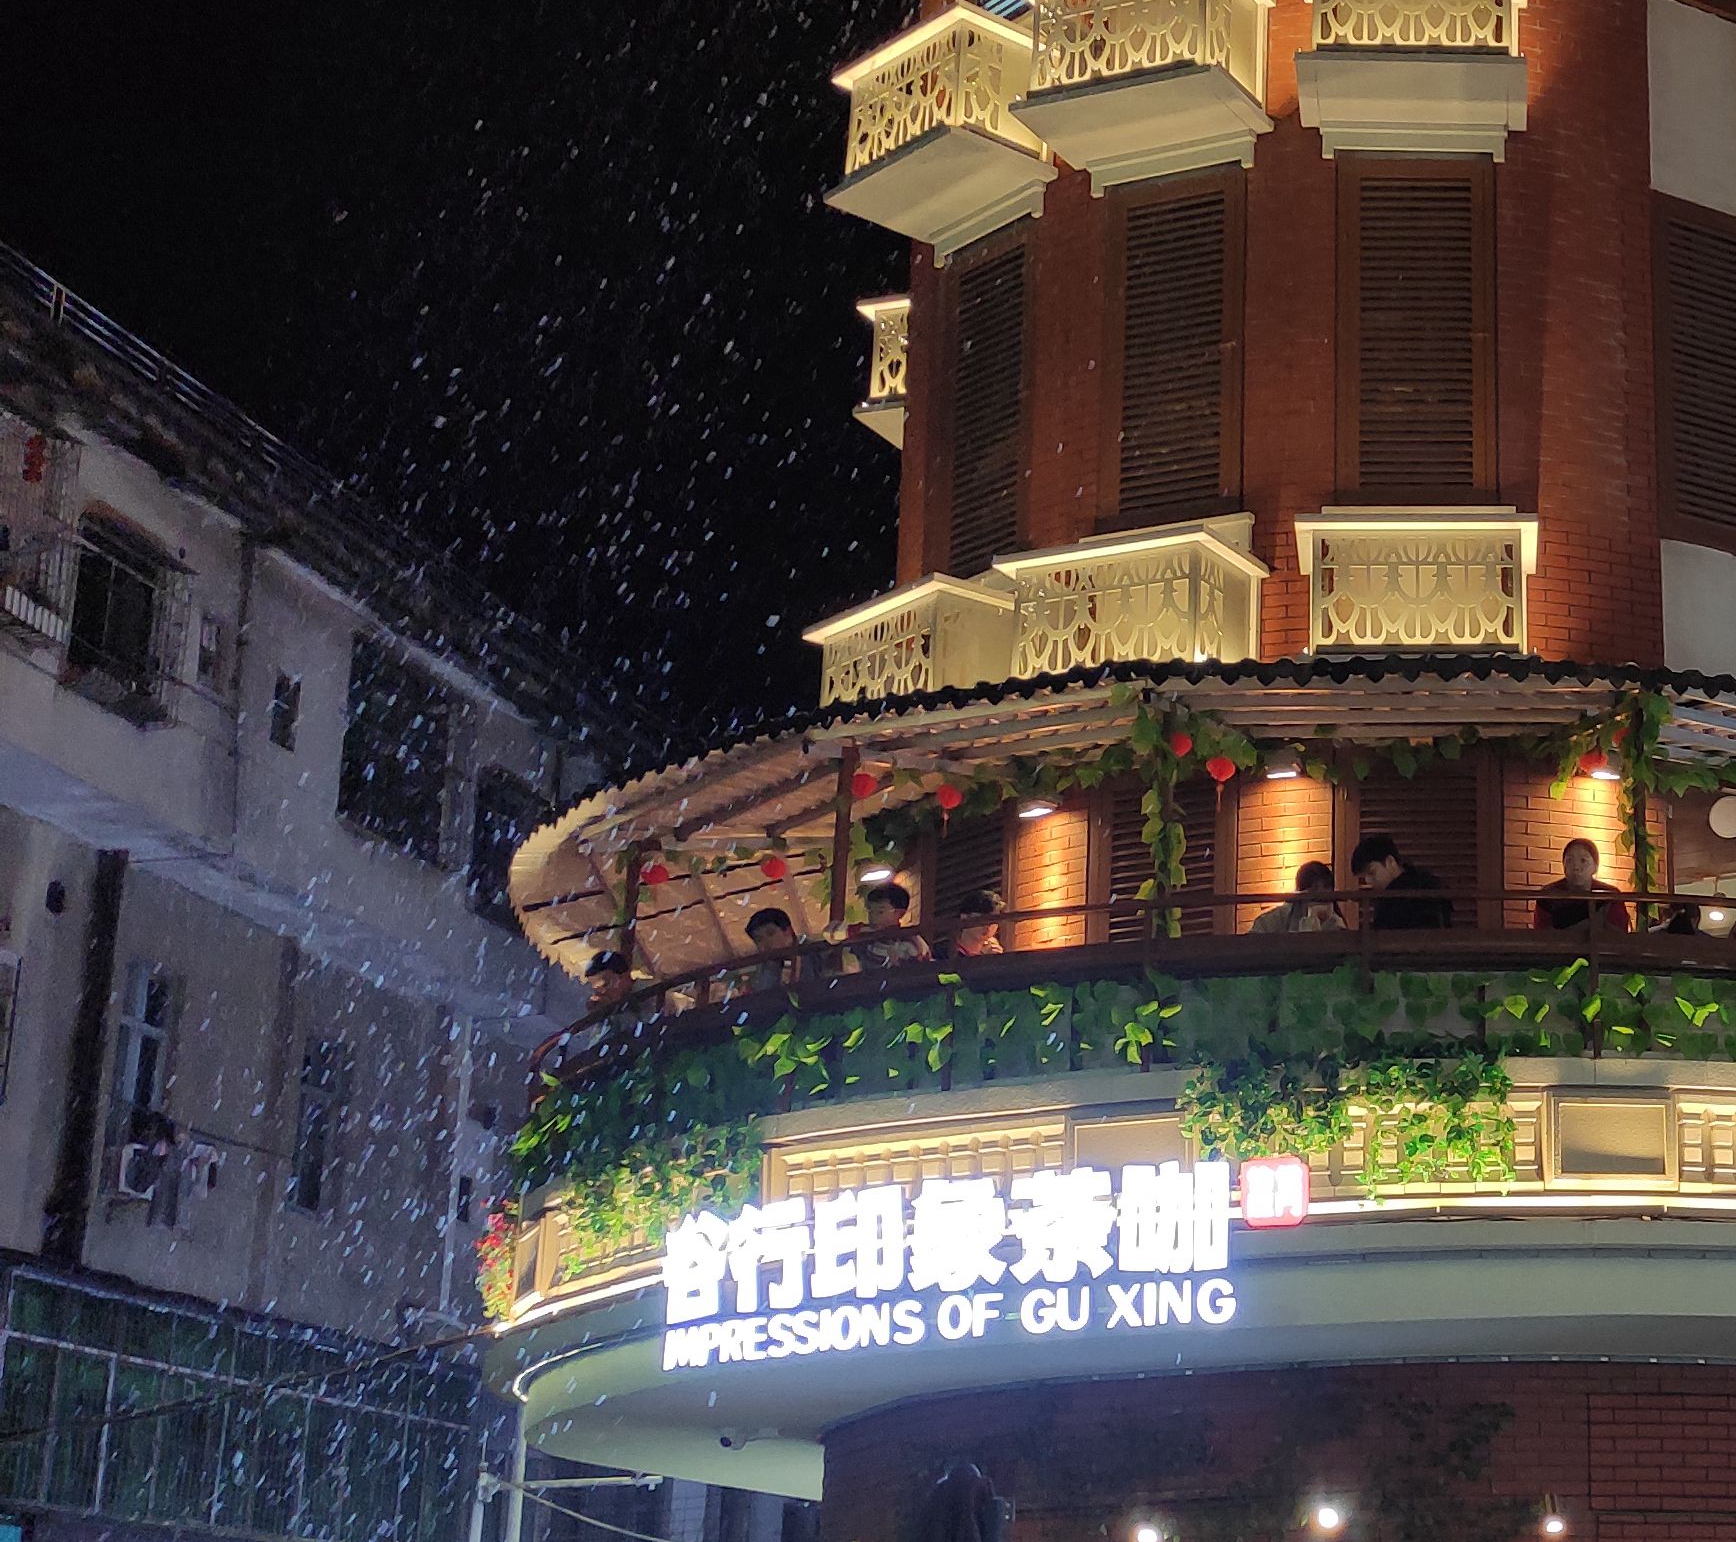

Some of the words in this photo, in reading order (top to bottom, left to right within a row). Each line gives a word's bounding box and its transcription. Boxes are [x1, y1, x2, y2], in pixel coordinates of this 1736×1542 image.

[660, 1159, 1231, 1326] 谷行印象茶咖
[662, 1299, 925, 1371] IMPRESSIONS
[937, 1290, 1003, 1341] OF
[1019, 1284, 1091, 1335] GU
[1105, 1277, 1237, 1329] XING
